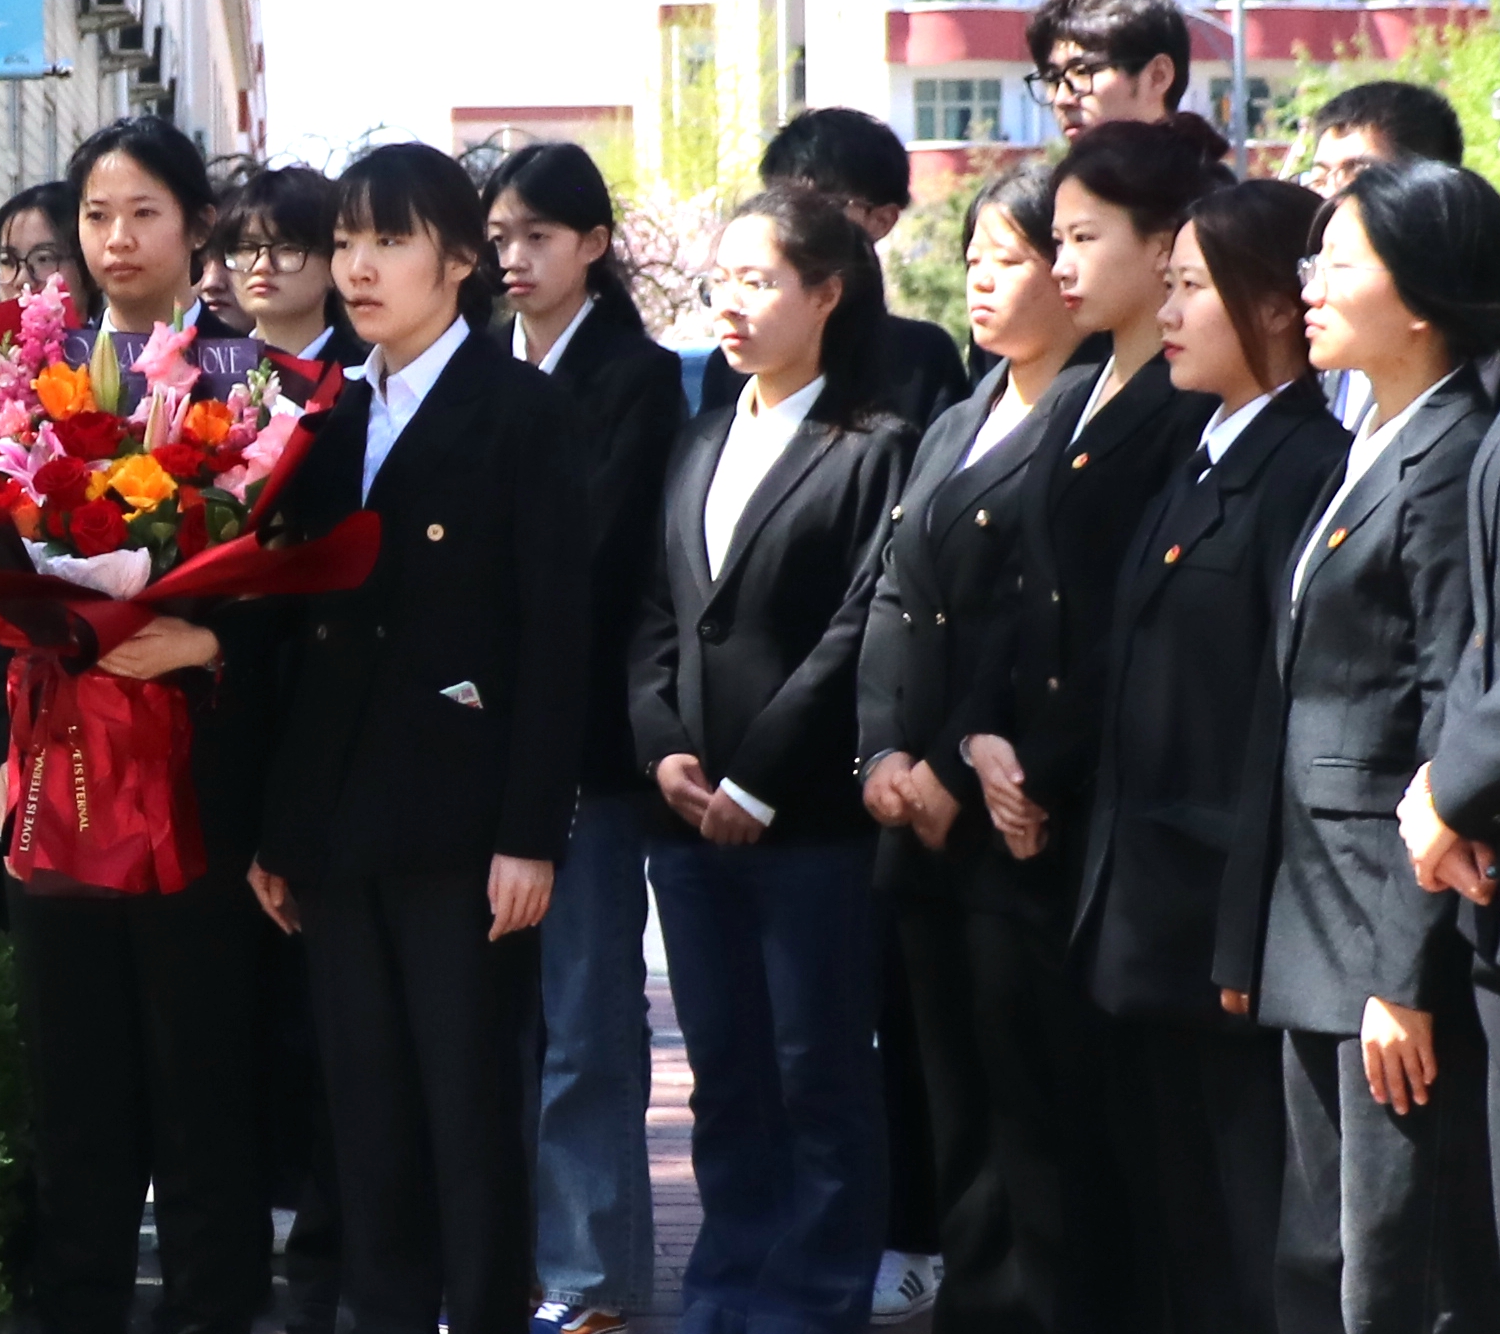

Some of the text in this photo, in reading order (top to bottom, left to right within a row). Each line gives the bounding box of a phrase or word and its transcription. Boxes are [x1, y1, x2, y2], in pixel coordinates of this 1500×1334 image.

[73, 763, 84, 776] IS
[25, 803, 37, 816] IS
[75, 777, 90, 832] ETERNAL
[19, 816, 35, 852] LOVE
